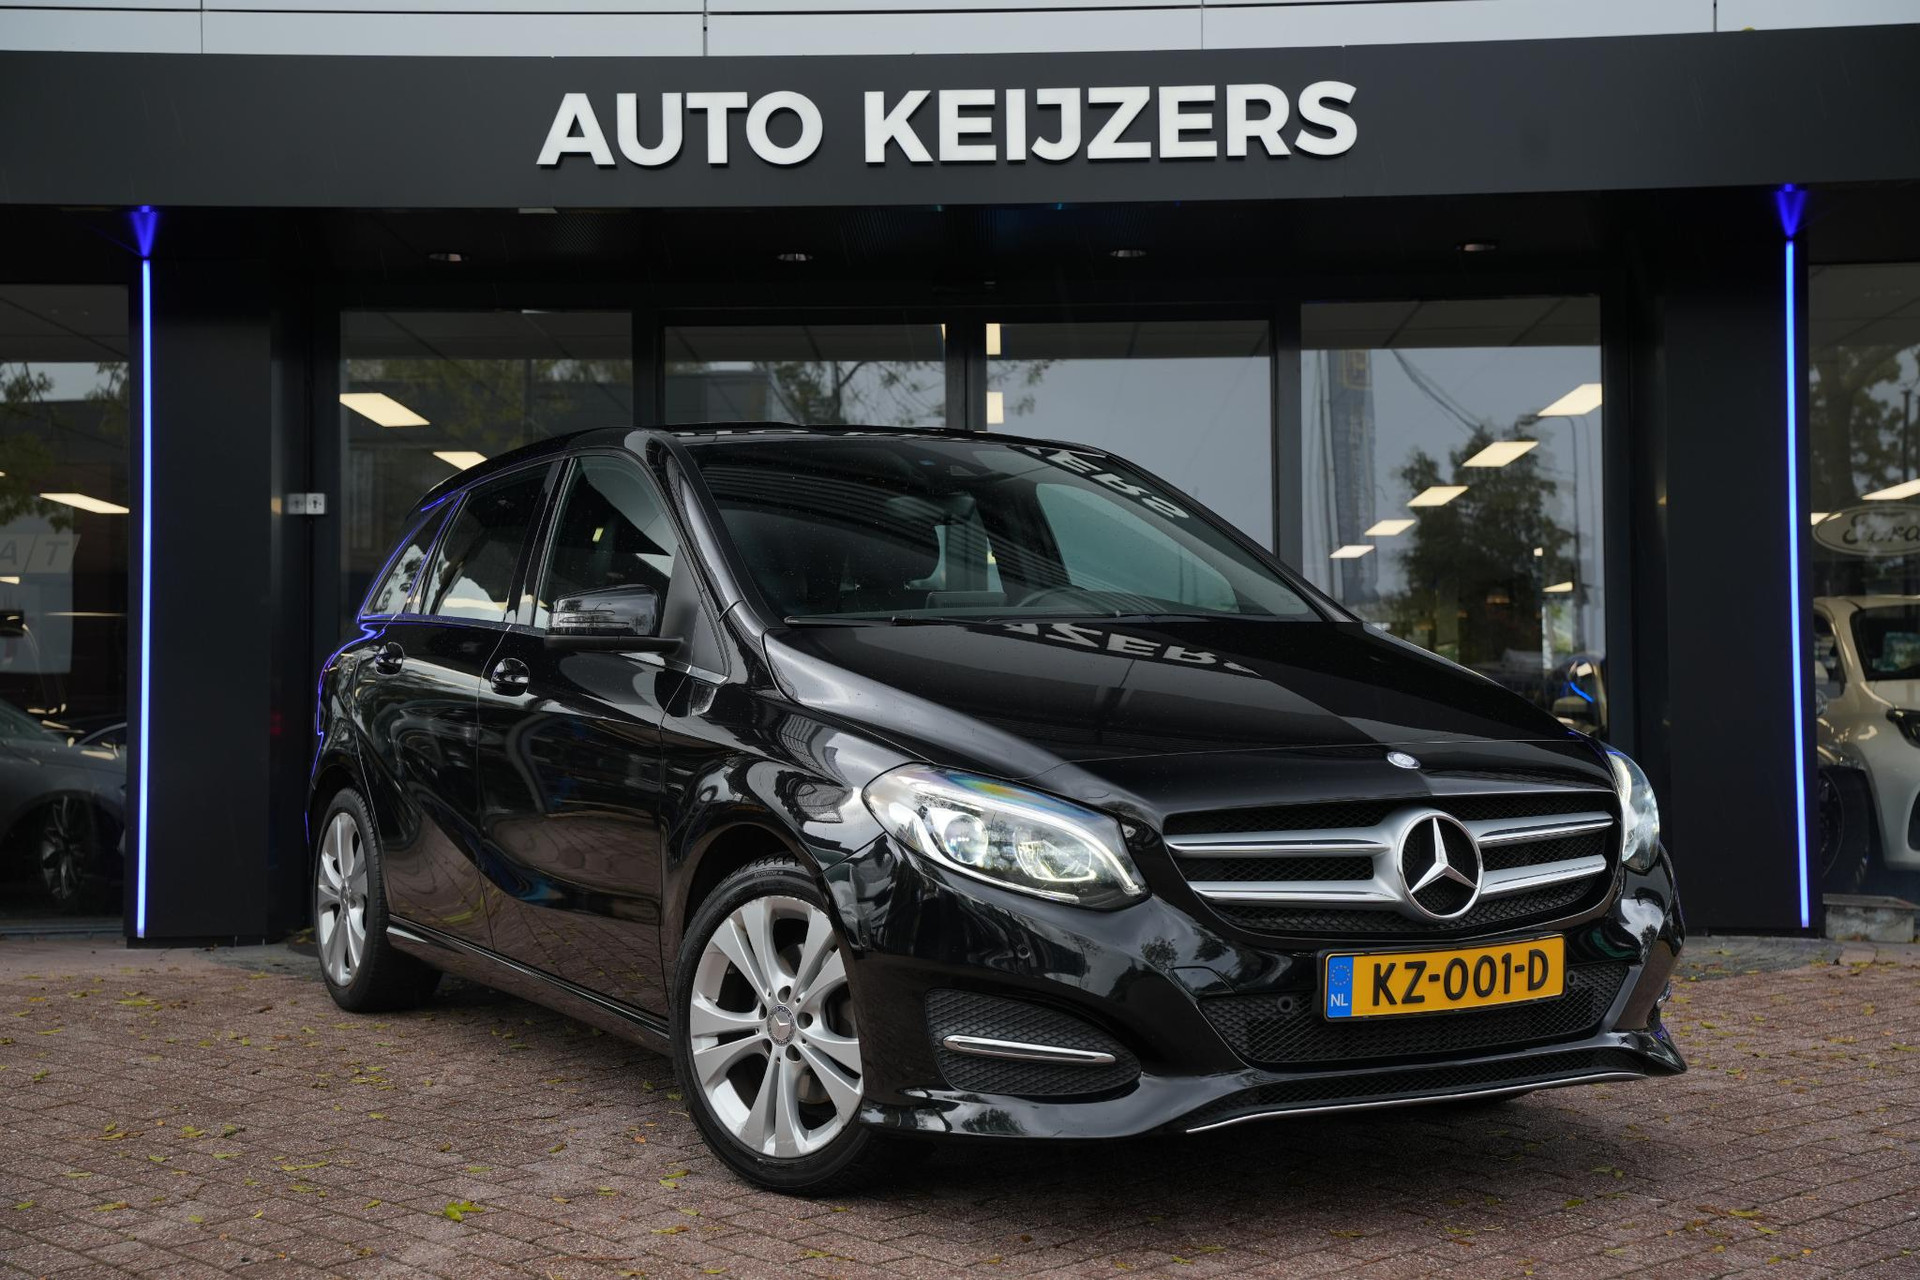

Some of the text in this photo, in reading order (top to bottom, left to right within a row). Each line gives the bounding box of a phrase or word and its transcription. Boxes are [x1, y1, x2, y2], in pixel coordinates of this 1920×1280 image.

[537, 81, 1359, 166] AUTO KEIJZERS
[1330, 993, 1349, 1007] NL
[1371, 948, 1549, 1007] KZ-001-D
